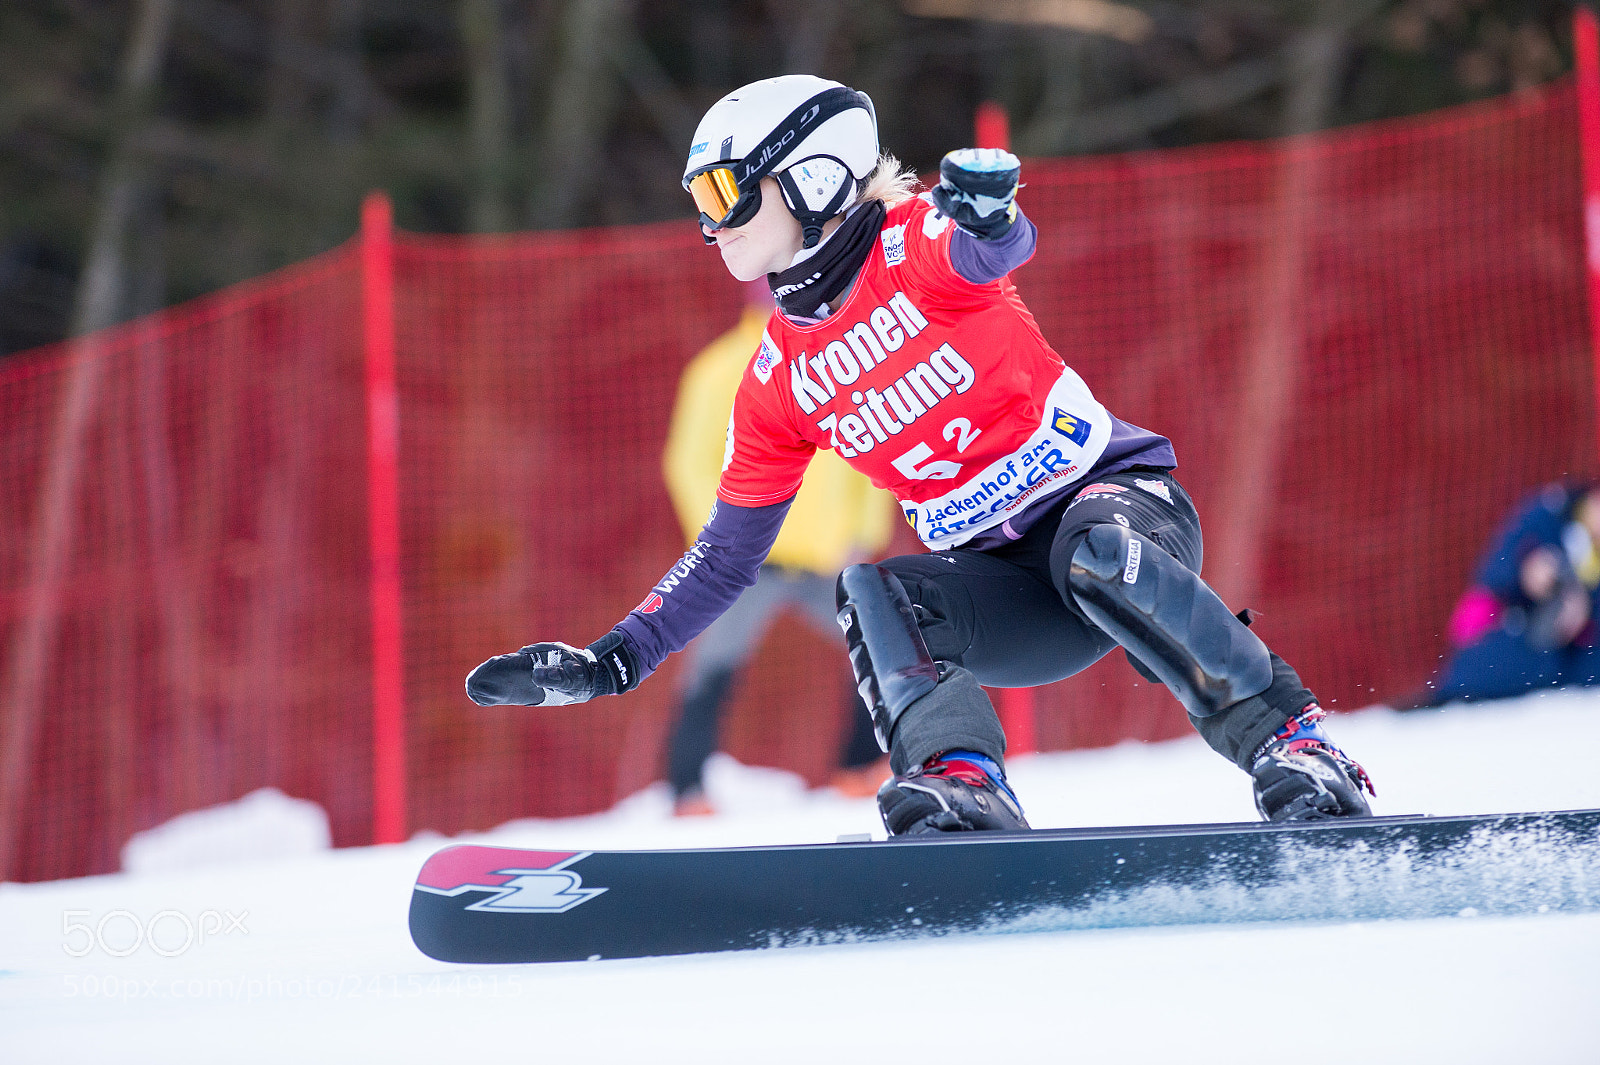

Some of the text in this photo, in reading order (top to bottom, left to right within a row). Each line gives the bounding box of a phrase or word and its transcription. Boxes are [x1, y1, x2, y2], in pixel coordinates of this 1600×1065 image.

[738, 129, 795, 185] Julbo
[789, 291, 930, 416] Kronen
[816, 341, 976, 458] Zeitung
[925, 438, 1052, 523] Lackenhof am
